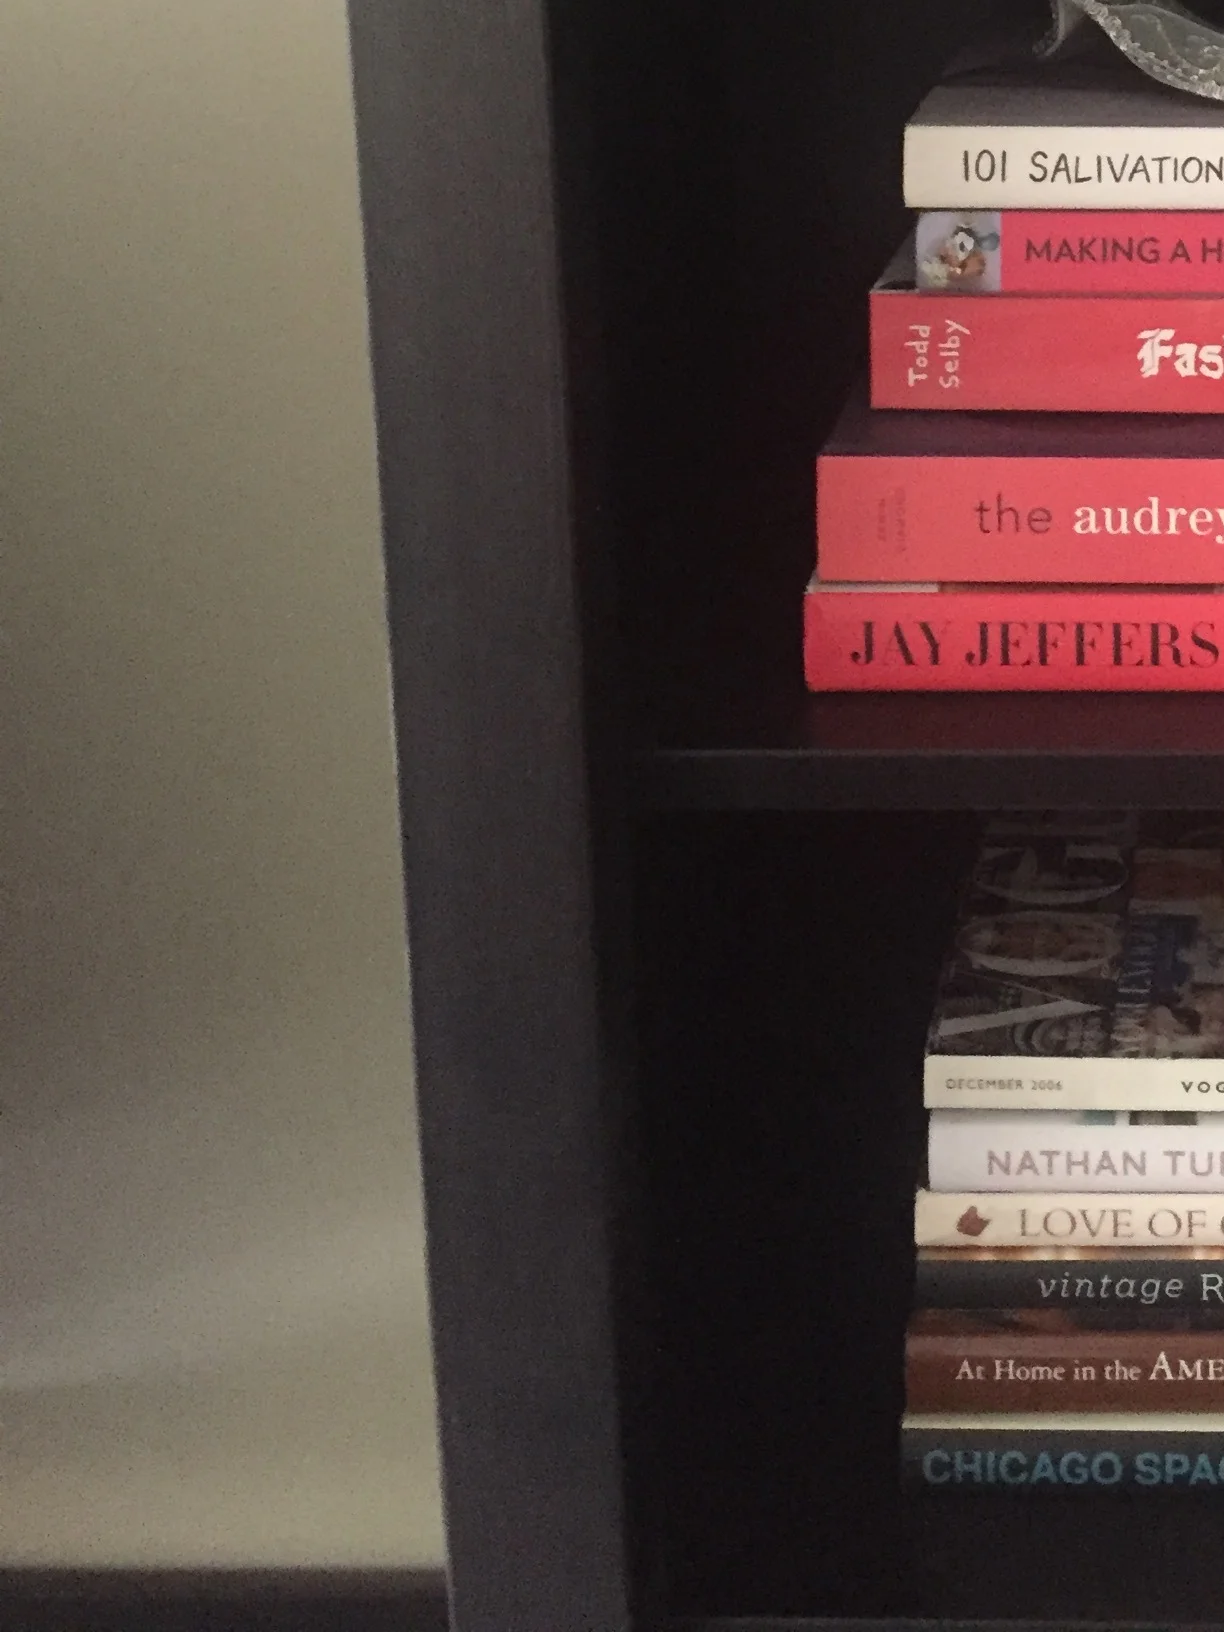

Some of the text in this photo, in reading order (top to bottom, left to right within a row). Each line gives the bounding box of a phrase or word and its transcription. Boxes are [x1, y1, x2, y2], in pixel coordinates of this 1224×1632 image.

[961, 149, 1007, 183] 101
[1024, 237, 1160, 264] MAKING
[1170, 237, 1192, 264] A
[904, 324, 931, 388] Todd
[938, 319, 972, 389] Selby
[974, 494, 1053, 534] the
[850, 620, 954, 668] JAY
[965, 620, 1221, 669] JEFFERS
[945, 1078, 1024, 1091] DECEMBER
[986, 1149, 1147, 1177] NATHAN
[1018, 1208, 1135, 1239] LOVE
[1147, 1208, 1207, 1239] OF
[1037, 1272, 1185, 1304] vintage
[955, 1359, 985, 1381] At
[994, 1359, 1065, 1381] Home
[1073, 1359, 1096, 1381] in
[1104, 1359, 1141, 1381] the
[921, 1450, 1124, 1486] CHICAGO
